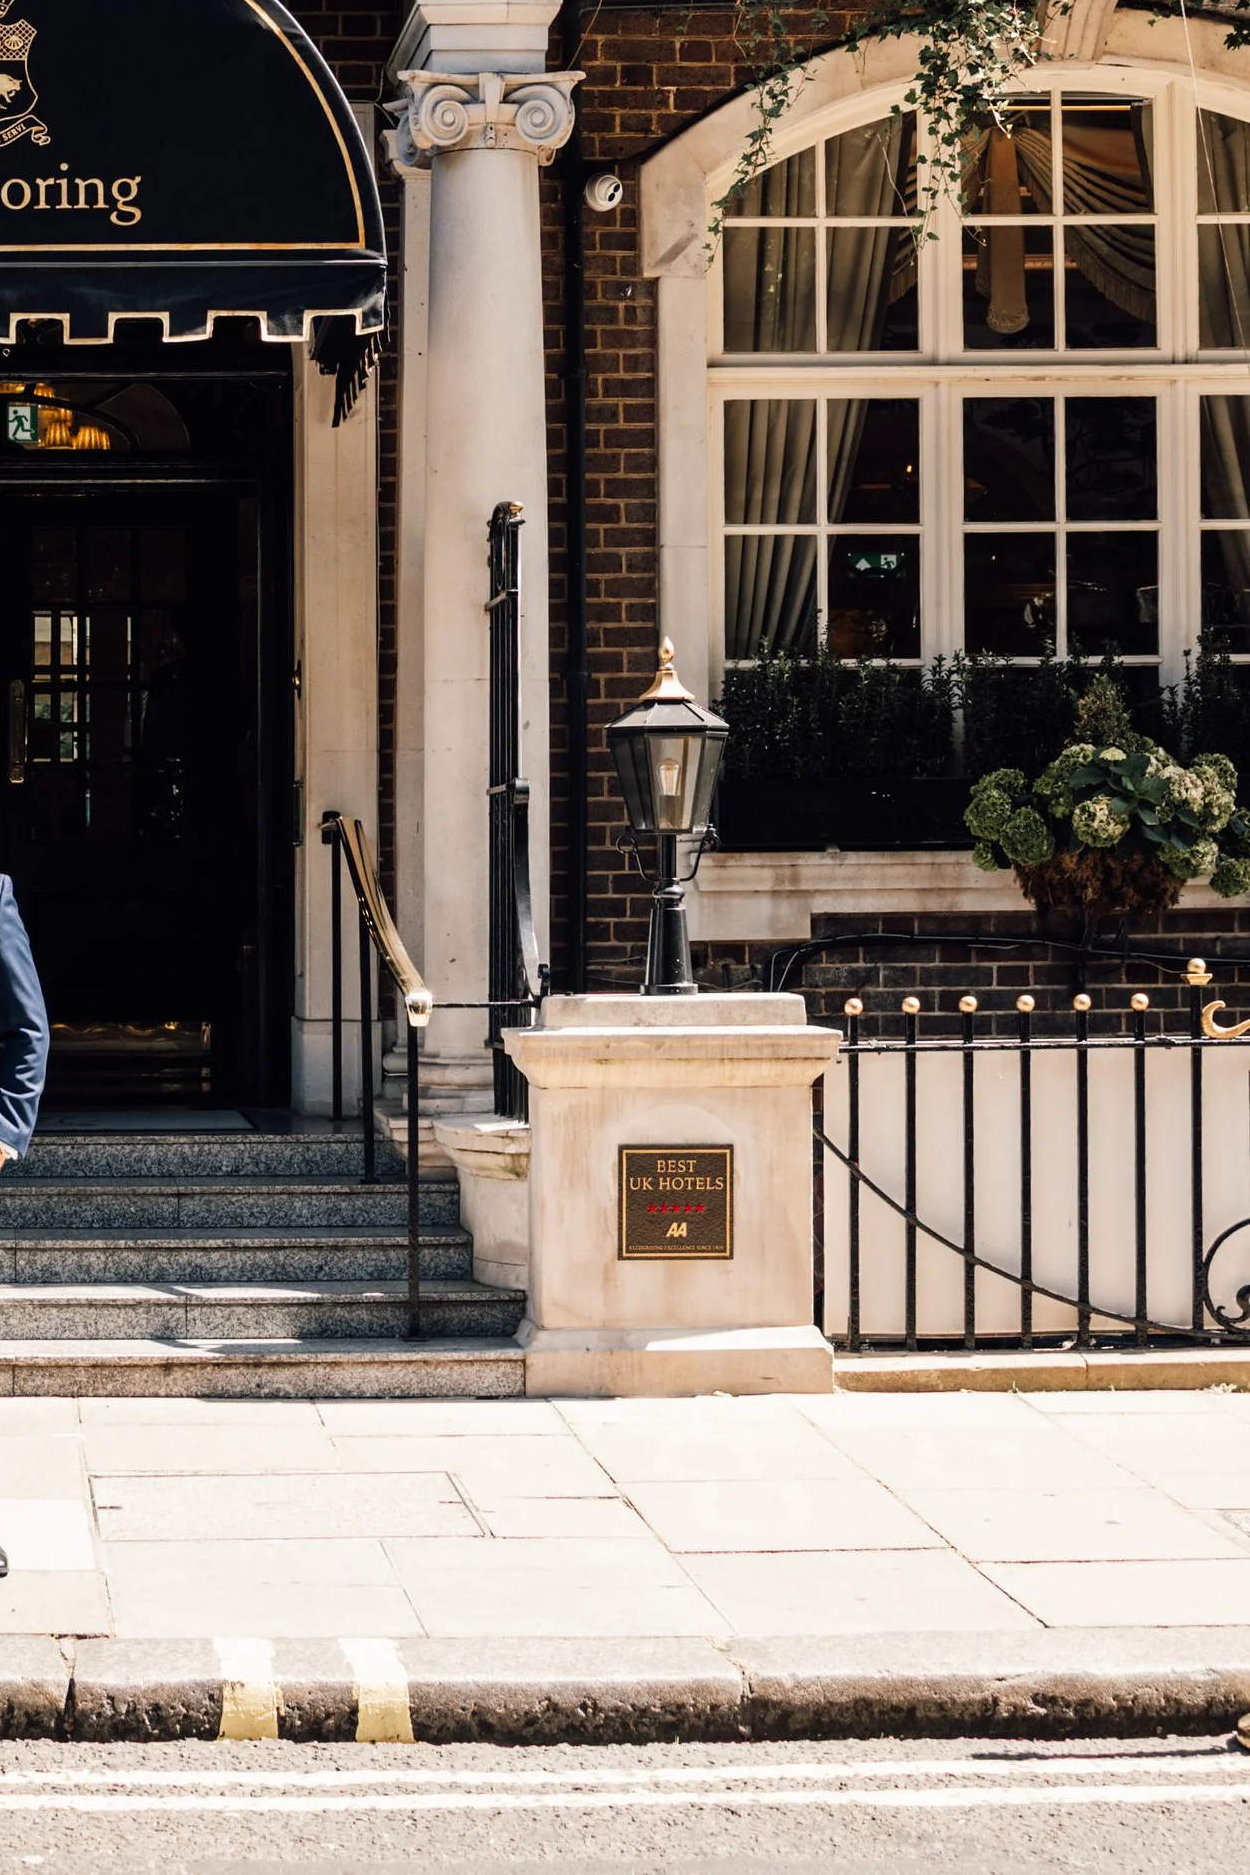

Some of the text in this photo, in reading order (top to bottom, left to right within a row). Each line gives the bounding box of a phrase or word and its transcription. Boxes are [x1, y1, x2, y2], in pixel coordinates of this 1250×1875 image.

[2, 123, 27, 141] SERVI
[656, 1159, 697, 1173] BEST
[630, 1177, 724, 1190] UK HOTELS
[665, 1222, 688, 1238] AA
